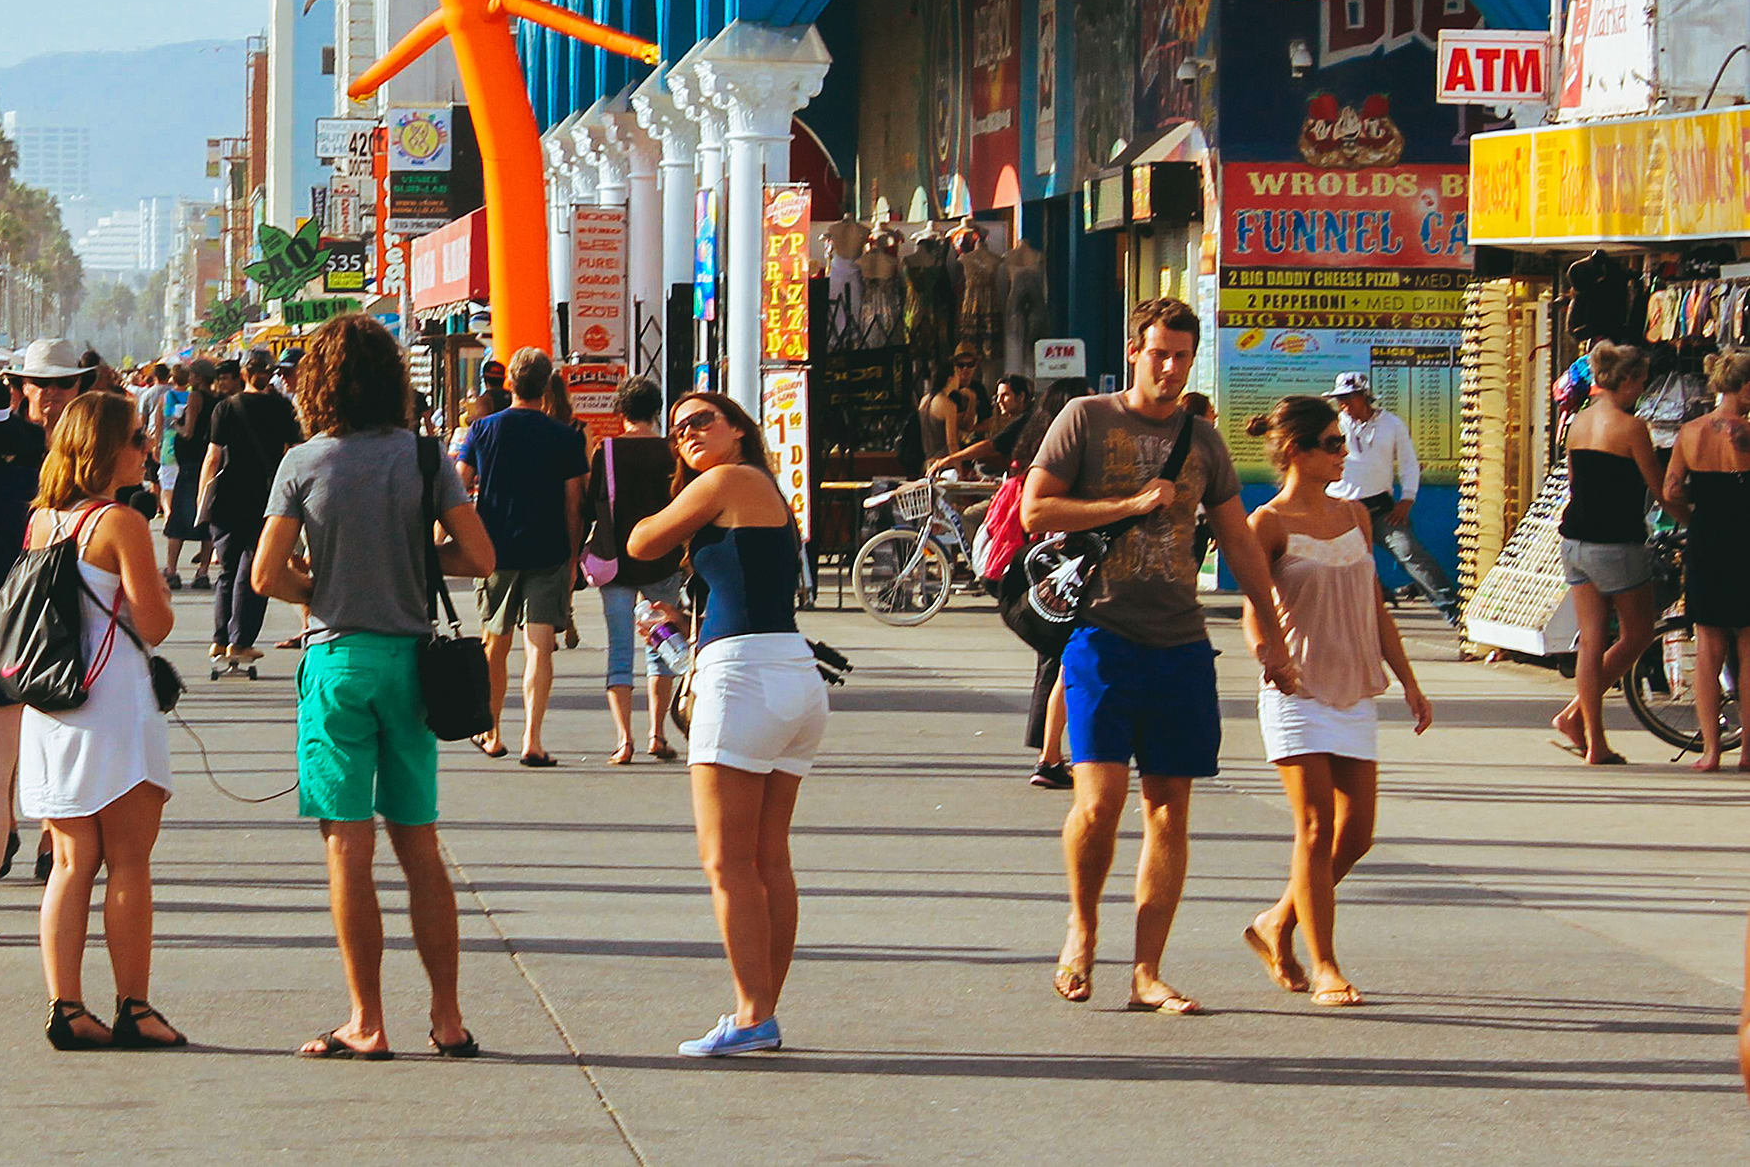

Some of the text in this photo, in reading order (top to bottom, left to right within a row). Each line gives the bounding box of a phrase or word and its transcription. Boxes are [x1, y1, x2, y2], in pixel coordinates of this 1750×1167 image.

[1443, 47, 1543, 93] ATM
[1246, 172, 1419, 197] WROLDS
[1232, 209, 1404, 255] FUNNEL
[382, 218, 406, 296] ream
[1228, 272, 1237, 286] 2
[1240, 270, 1264, 286] BIG
[1267, 271, 1311, 287] DADDY
[1314, 271, 1363, 288] CHEESE
[1366, 273, 1400, 288] PIZZA
[1414, 273, 1453, 288] MED
[764, 234, 784, 353] FRIED
[785, 231, 806, 357] PIZZA
[1247, 294, 1257, 308] 2
[1263, 294, 1346, 309] PEPPERONI
[1366, 296, 1405, 310] MED
[312, 301, 328, 320] IS
[1225, 313, 1277, 327] BIG
[1285, 314, 1383, 328] DADDY
[1044, 345, 1075, 358] ATM
